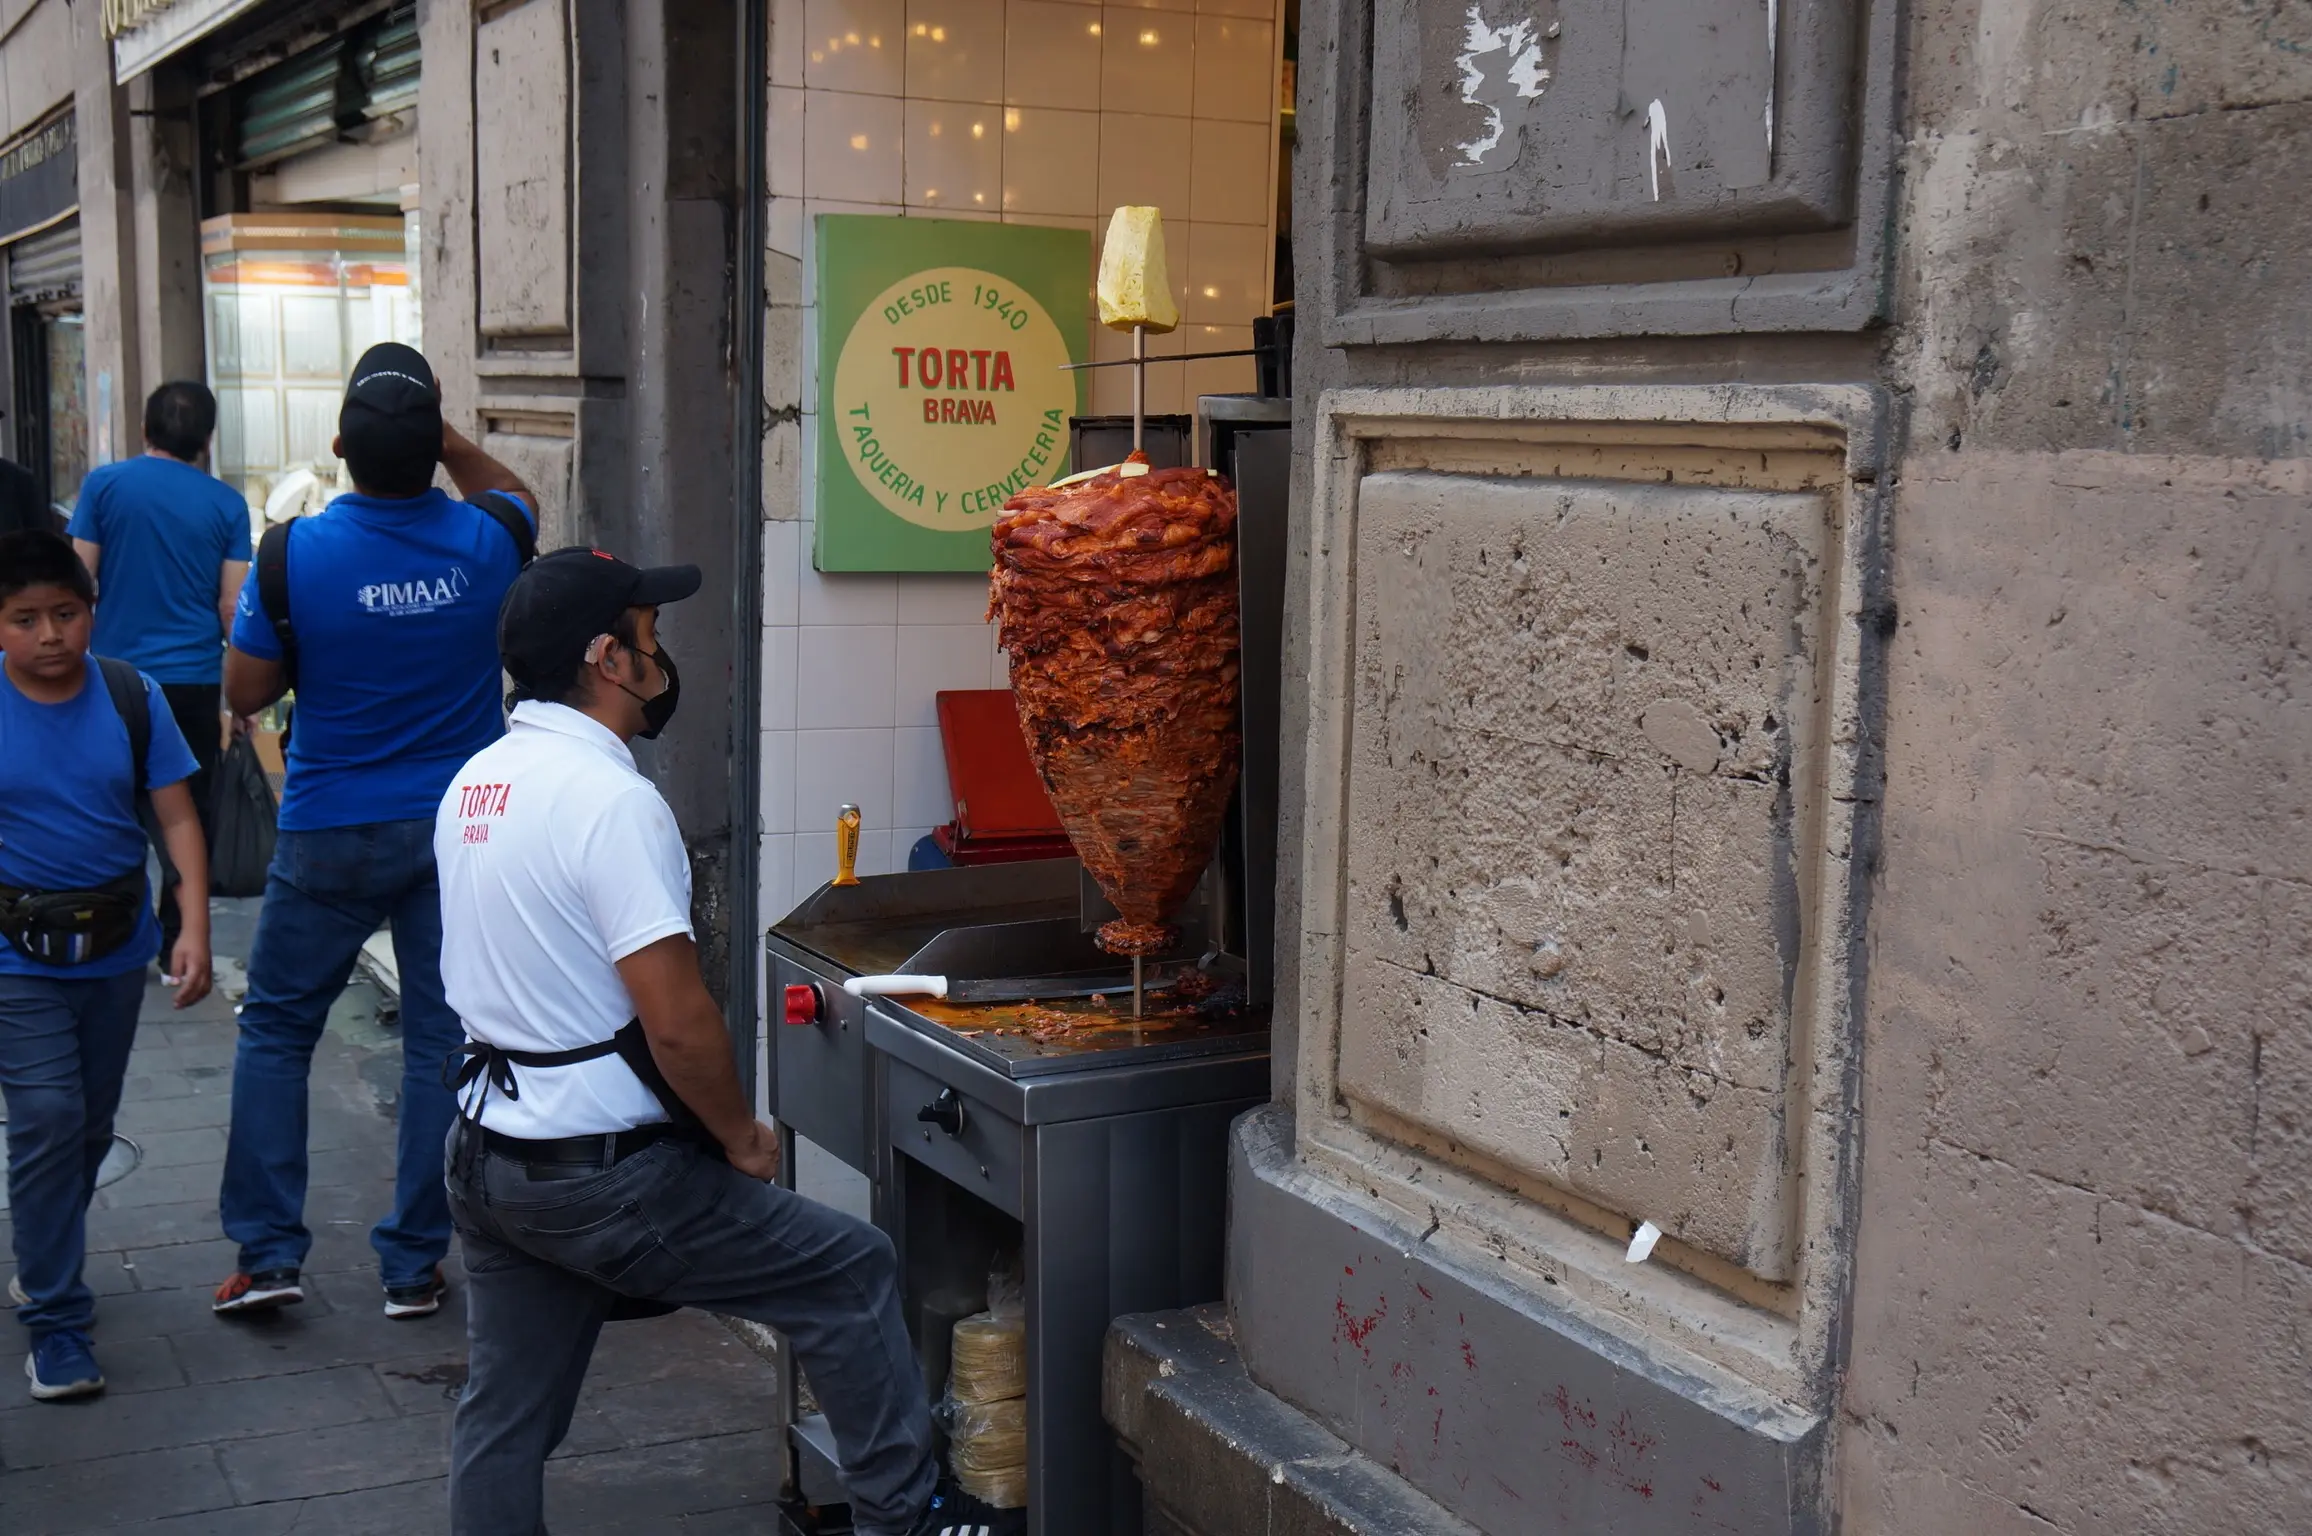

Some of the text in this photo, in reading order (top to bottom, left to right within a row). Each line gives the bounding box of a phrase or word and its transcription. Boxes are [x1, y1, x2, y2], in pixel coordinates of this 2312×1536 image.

[884, 281, 1028, 331] DESDE 1940
[892, 347, 1015, 391] TORTA
[923, 398, 997, 426] BRAVA
[850, 402, 1063, 515] TAQUERIA Y CERVECERIA
[366, 577, 452, 607] PIMAA
[459, 783, 511, 818] TORTA
[463, 824, 489, 844] BRAVA
